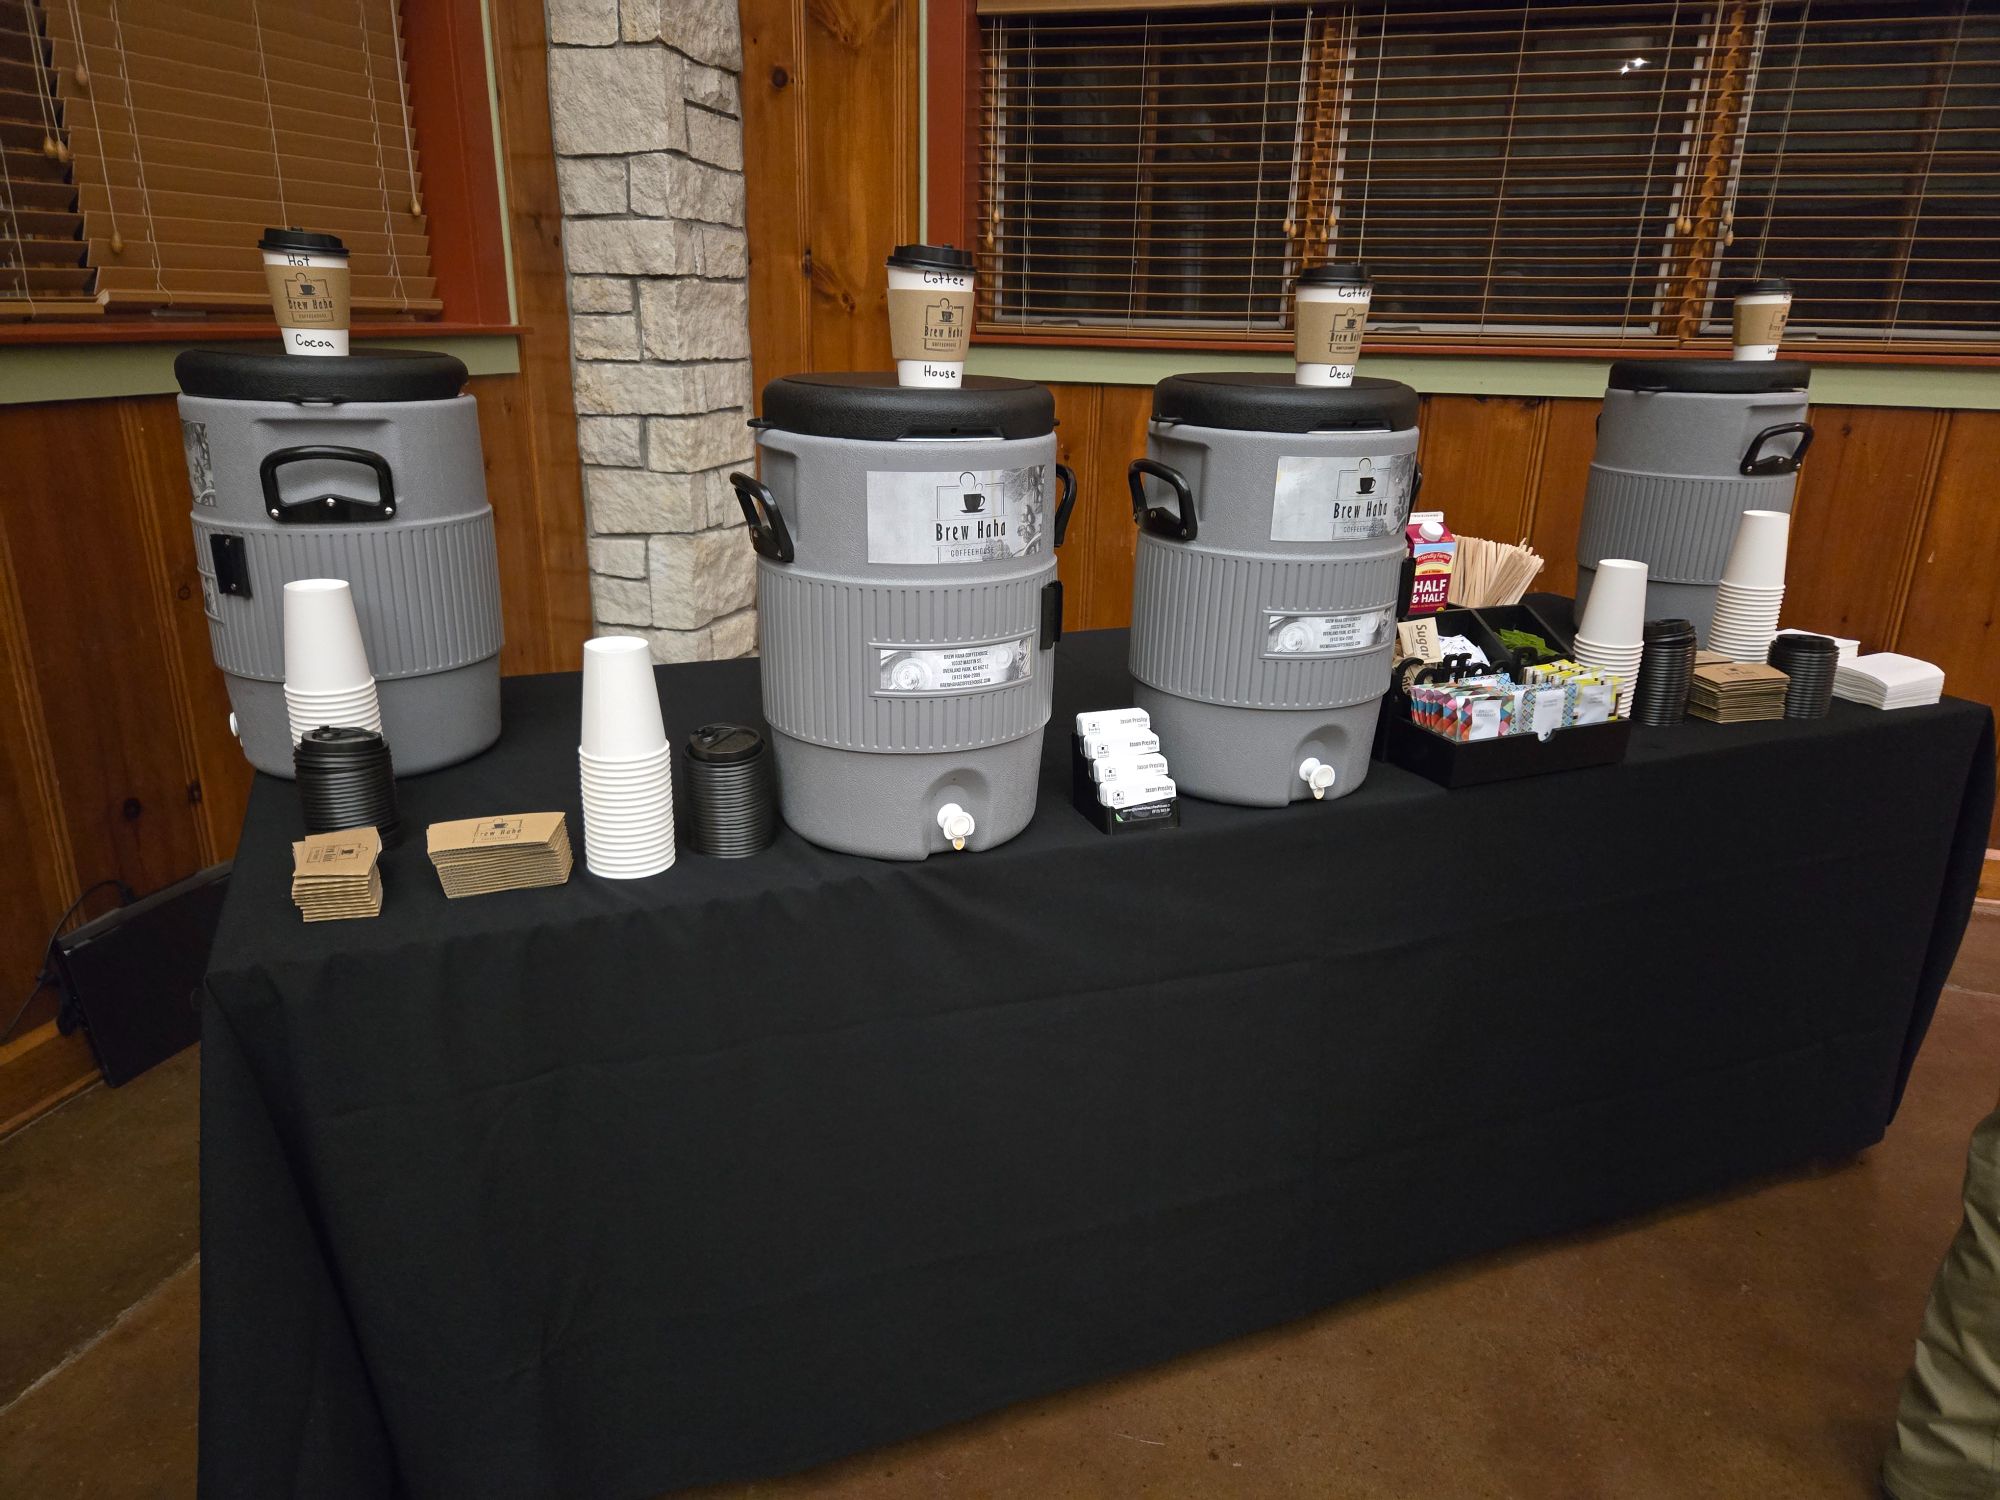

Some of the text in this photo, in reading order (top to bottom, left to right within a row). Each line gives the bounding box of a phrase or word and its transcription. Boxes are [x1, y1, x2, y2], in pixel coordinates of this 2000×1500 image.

[287, 253, 310, 267] Hot
[923, 270, 964, 287] Coffee
[288, 298, 333, 310] Brew Haha
[924, 325, 944, 338] Brew
[1330, 332, 1348, 342] Brew
[295, 333, 335, 349] Cocoa
[924, 364, 956, 379] House
[1333, 500, 1388, 519] Brew Haha
[935, 518, 1007, 542] Brew Haha
[1343, 525, 1379, 533] COFFEEHOUSE
[950, 546, 995, 558] COFFEEHOUSE
[1413, 578, 1447, 594] HALF
[1411, 592, 1445, 604] & HALF
[1415, 624, 1430, 658] Sugar
